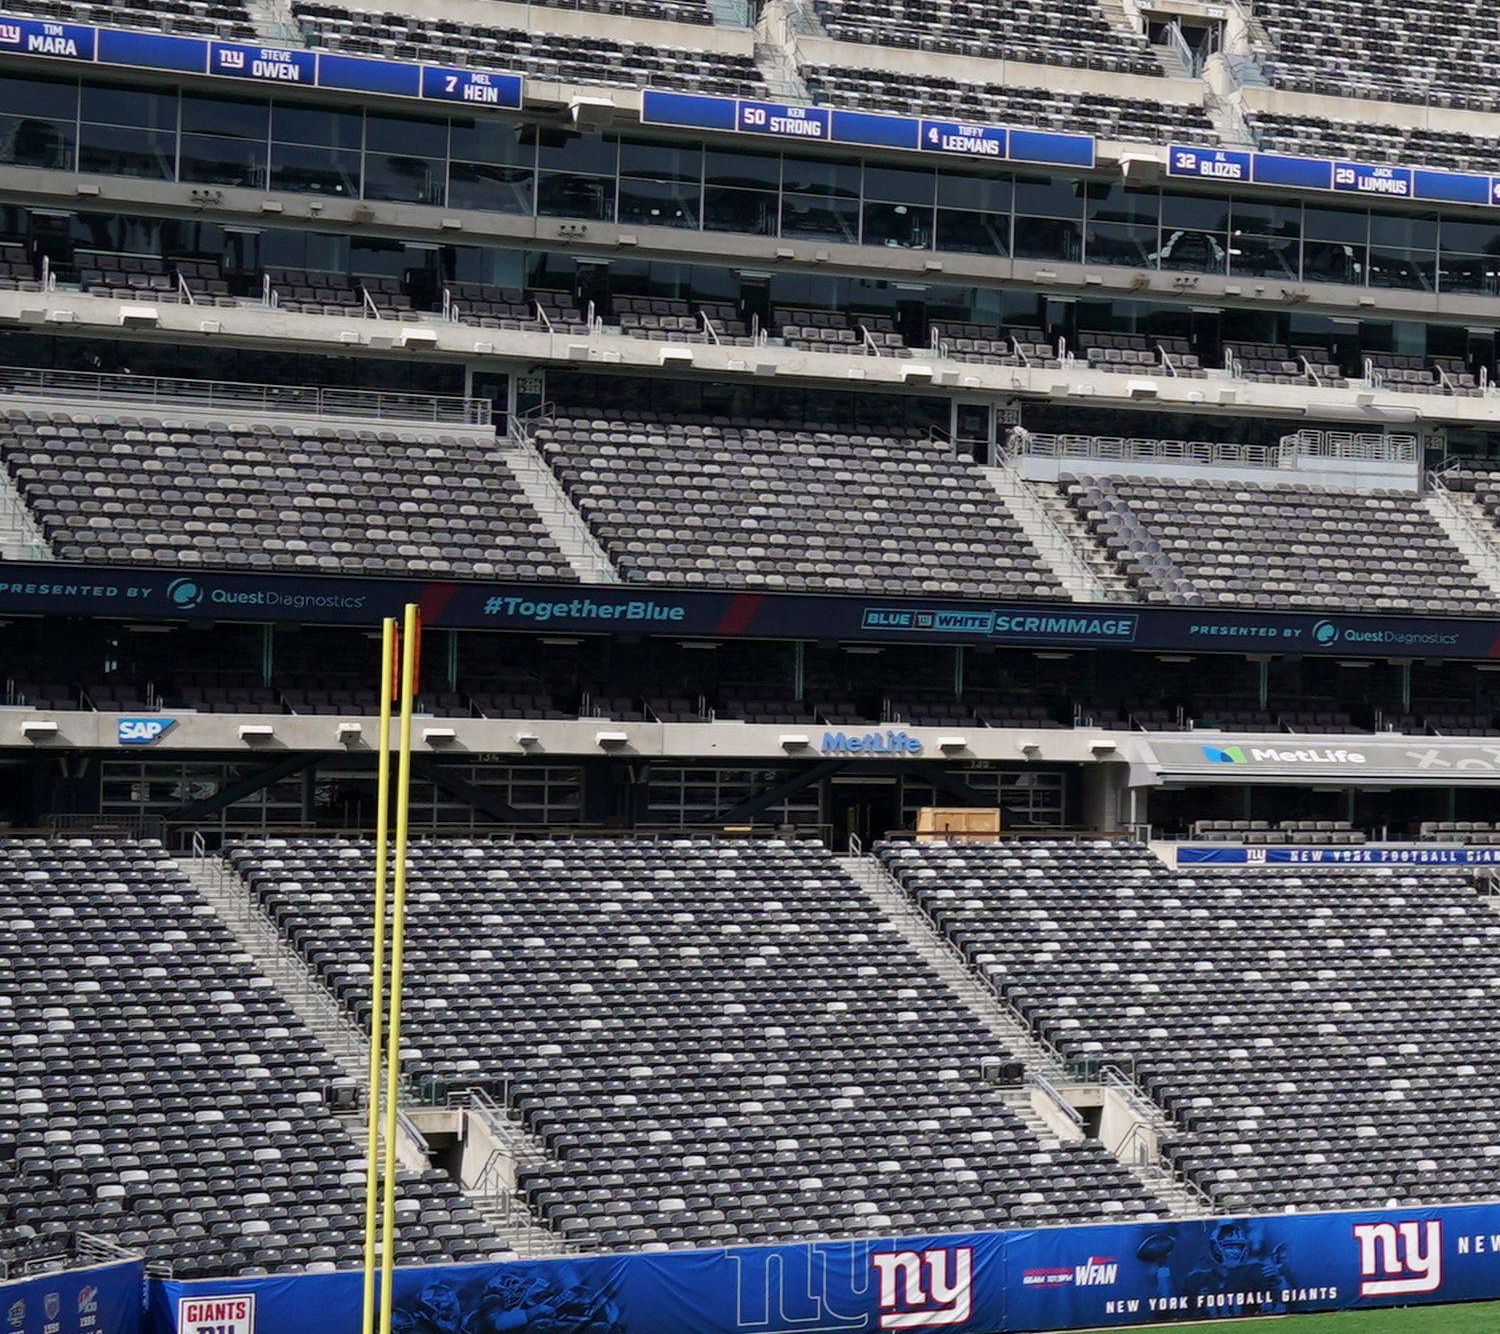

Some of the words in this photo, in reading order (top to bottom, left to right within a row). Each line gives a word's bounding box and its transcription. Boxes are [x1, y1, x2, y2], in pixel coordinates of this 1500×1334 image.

[28, 33, 77, 56] MARA
[260, 48, 292, 62] STEVE
[252, 59, 299, 80] OWEN
[464, 83, 499, 103] HEIN
[744, 108, 765, 126] 50
[769, 117, 821, 135] STRONG
[942, 134, 999, 154] LEEMANS
[1176, 153, 1196, 169] 32
[1200, 161, 1241, 179] BLOZIS
[1336, 169, 1354, 184] 29
[1358, 177, 1407, 195] LUMMUS
[0, 583, 118, 597] PRESENTED
[484, 596, 685, 621] #TogetherBlue
[866, 612, 911, 625] BLUE
[995, 617, 1132, 635] SCRIMMAGE
[1190, 625, 1277, 637] PRESENTED
[120, 722, 162, 739] SAP
[821, 731, 922, 754] MetLife
[1251, 748, 1366, 763] MetLife
[1352, 1219, 1441, 1297] ny
[1075, 1257, 1118, 1286] WFAN
[871, 1246, 974, 1329] ny
[1106, 1300, 1140, 1314] NEW
[1150, 1296, 1188, 1311] YORK
[1197, 1290, 1273, 1307] FOOTBALL
[1282, 1286, 1338, 1302] GIANTS
[187, 1301, 245, 1324] GIANTS
